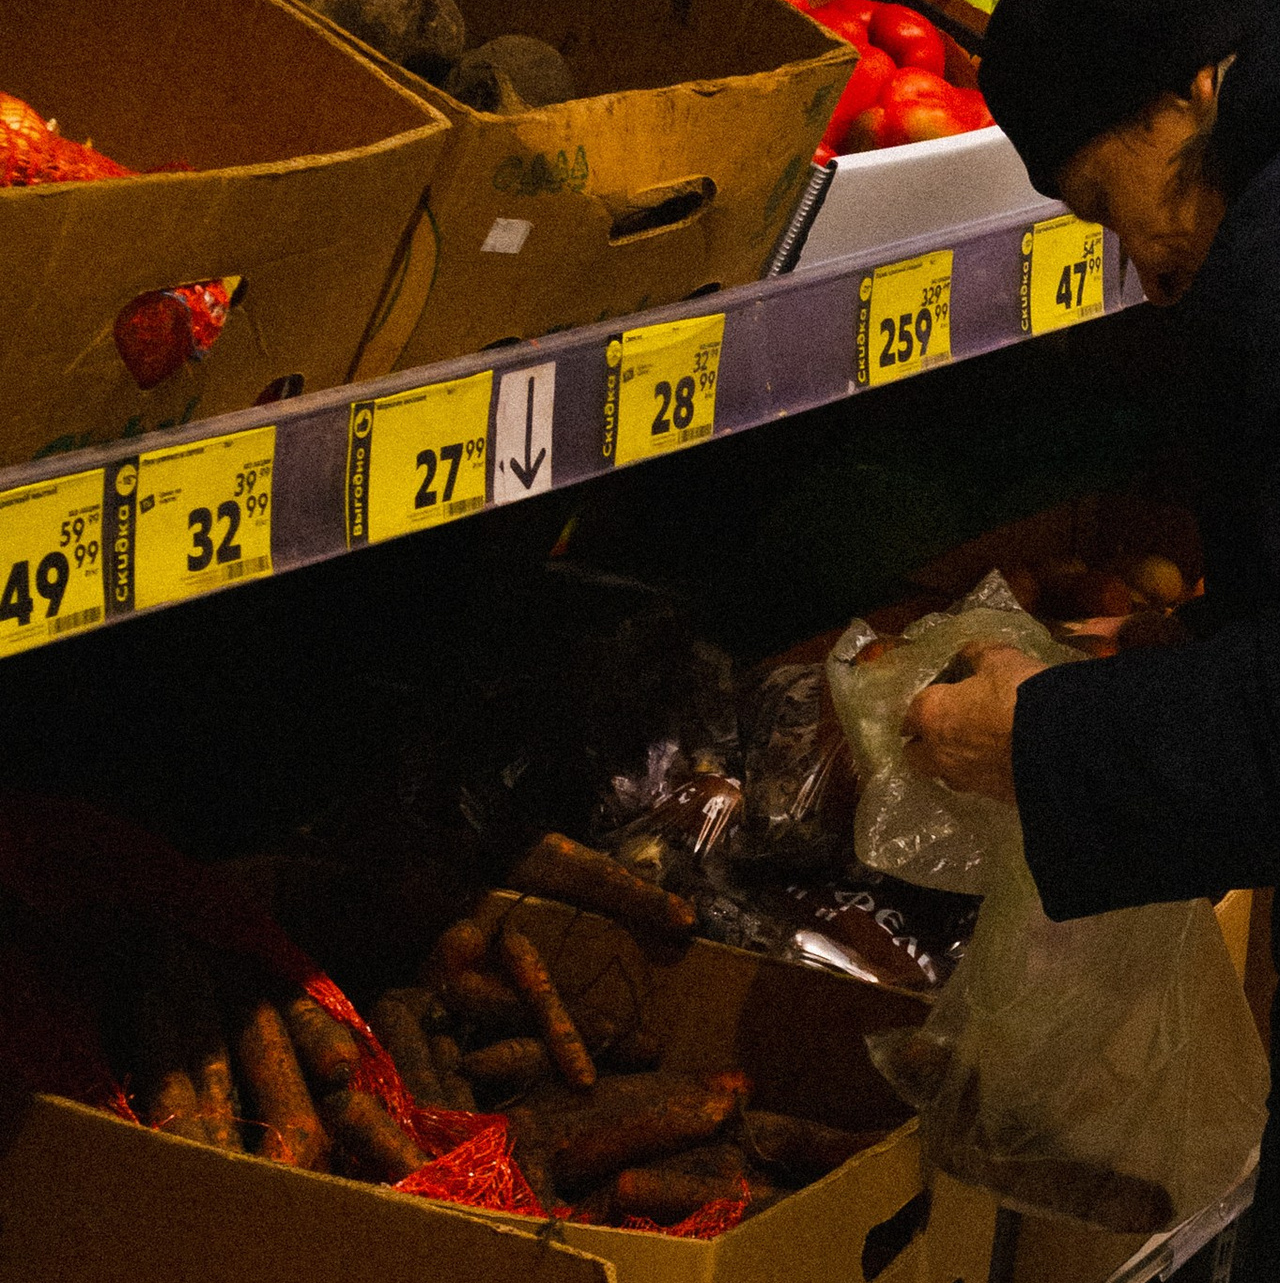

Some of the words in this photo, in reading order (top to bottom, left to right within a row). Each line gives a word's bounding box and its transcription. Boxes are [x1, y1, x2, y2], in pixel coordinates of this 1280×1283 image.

[920, 285, 943, 307] 329
[1020, 260, 1030, 332] Скидка
[1056, 260, 1088, 311] 47
[1088, 256, 1101, 276] 99
[693, 351, 709, 374] 32
[857, 308, 868, 384] Скидка
[879, 308, 933, 368] 259
[934, 302, 948, 324] 99
[601, 374, 617, 458] Скидка
[651, 375, 696, 436] 28
[699, 370, 716, 392] 99
[233, 469, 258, 498] 39
[352, 447, 366, 537] Выгодно
[415, 443, 464, 509] 27
[465, 437, 485, 460] 99
[59, 517, 86, 548] 59
[114, 504, 131, 603] Скидка
[187, 499, 242, 572] 32
[245, 492, 269, 519] 99
[0, 551, 71, 626] 49
[73, 540, 99, 569] 99
